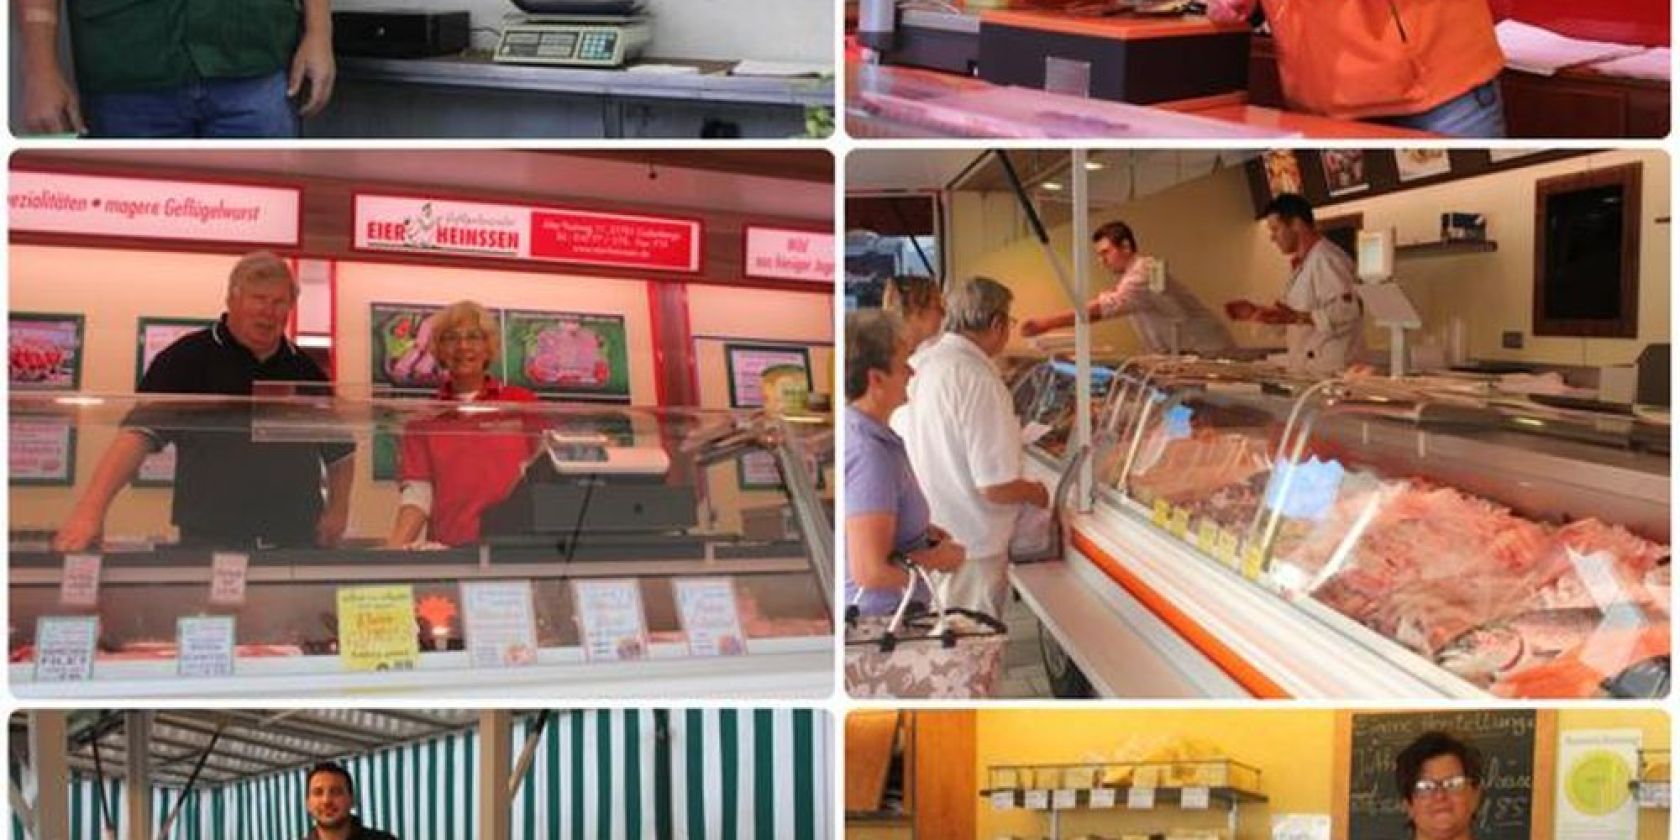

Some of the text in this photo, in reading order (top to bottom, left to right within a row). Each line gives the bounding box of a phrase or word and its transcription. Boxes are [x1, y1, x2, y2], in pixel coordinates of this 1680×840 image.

[105, 199, 160, 219] magere
[164, 197, 260, 223] Geflügelwurst
[367, 221, 405, 240] EIER
[436, 223, 520, 248] HEINSSEN
